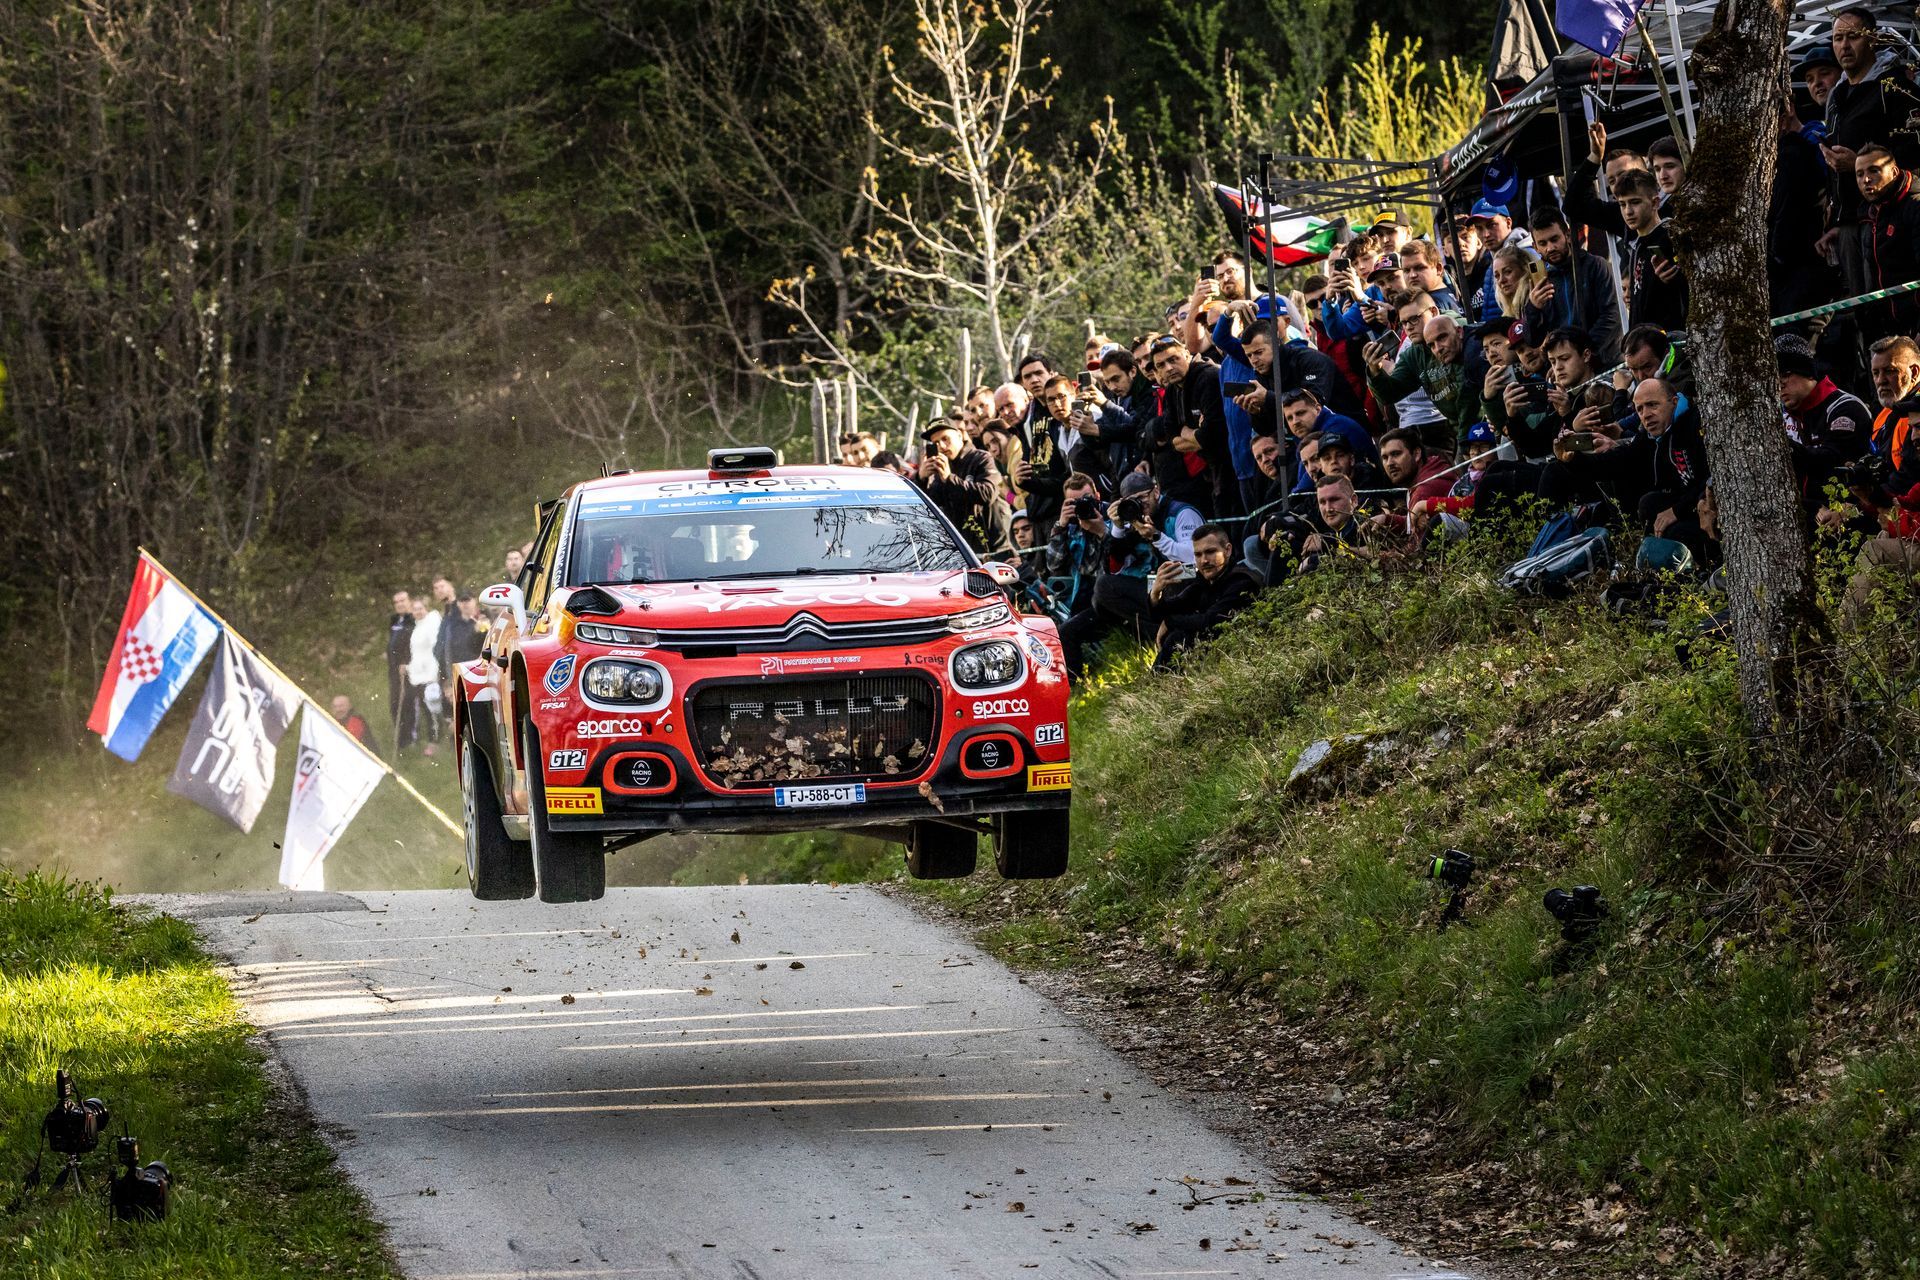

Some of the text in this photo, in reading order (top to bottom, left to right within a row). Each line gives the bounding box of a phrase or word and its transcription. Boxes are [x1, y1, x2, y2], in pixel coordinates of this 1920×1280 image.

[687, 591, 911, 613] YACCO
[915, 653, 945, 665] Craig
[973, 699, 1029, 719] sparco
[577, 719, 642, 739] sparco
[1036, 723, 1064, 742] GT2i
[550, 750, 587, 768] GT2i
[547, 793, 596, 809] IRELLI
[790, 787, 851, 803] FJ-588-CT
